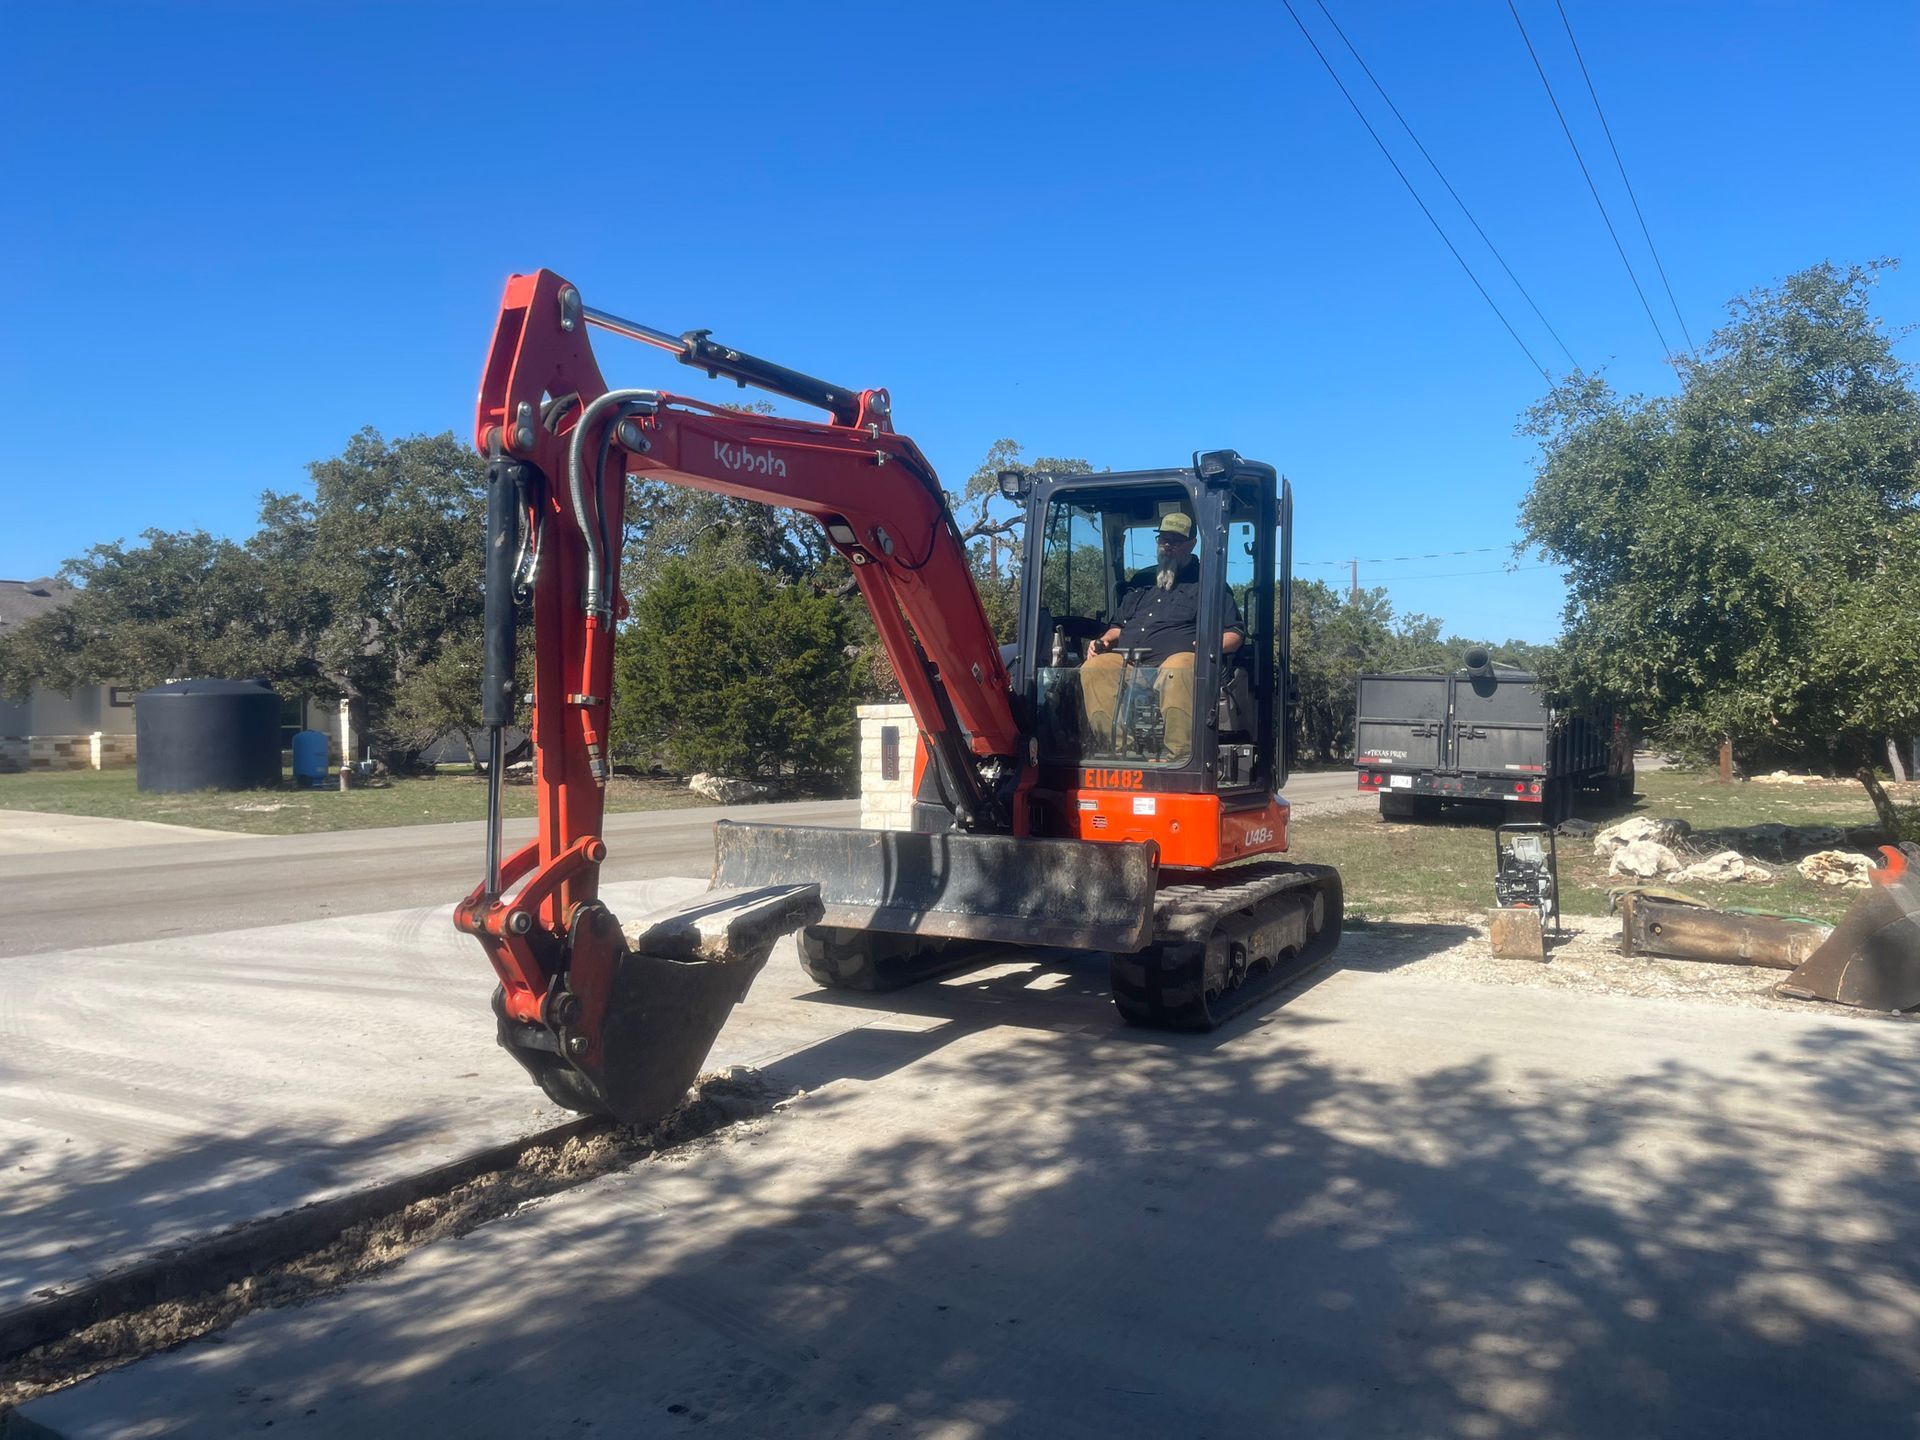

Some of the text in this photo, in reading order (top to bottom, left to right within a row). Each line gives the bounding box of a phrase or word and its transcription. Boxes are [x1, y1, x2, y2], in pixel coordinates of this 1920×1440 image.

[713, 440, 787, 478] Kubota
[1369, 749, 1390, 757] TEXAS
[1085, 768, 1144, 790] E11482
